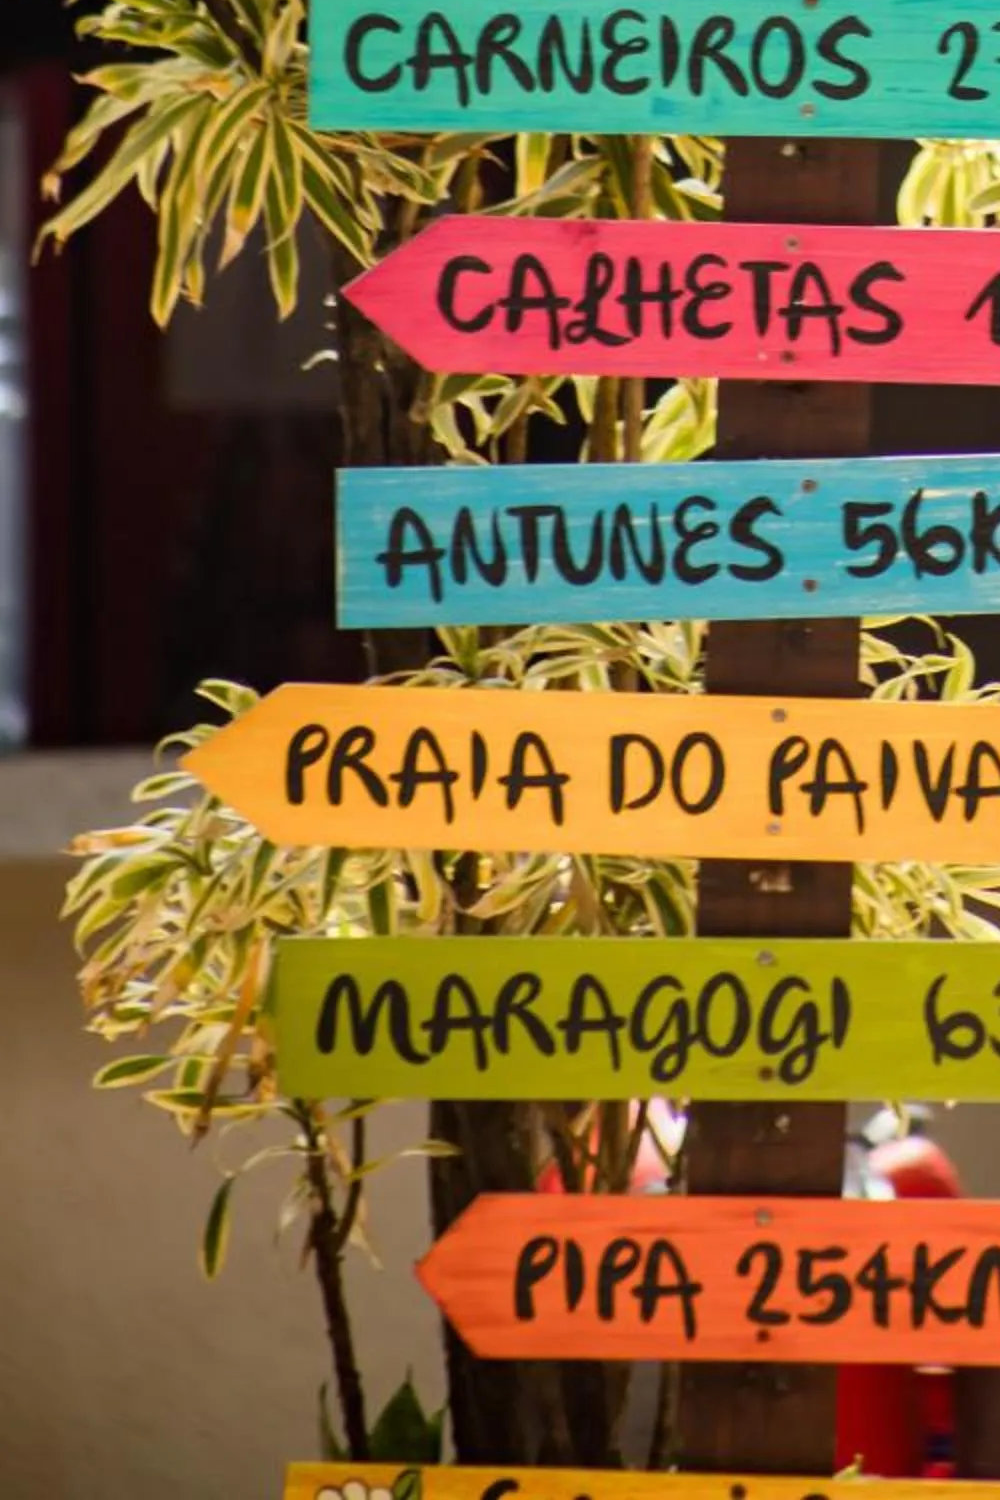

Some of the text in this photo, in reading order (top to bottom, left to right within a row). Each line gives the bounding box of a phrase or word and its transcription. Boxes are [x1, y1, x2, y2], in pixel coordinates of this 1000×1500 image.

[342, 8, 872, 109] CARNEIROS
[437, 252, 903, 354] CALHETAS
[373, 494, 786, 604] ANTUNES
[285, 723, 570, 825] PRAIA
[610, 732, 726, 815] DO
[313, 970, 852, 1086] MARAGOGI
[514, 1236, 702, 1339] PIPA
